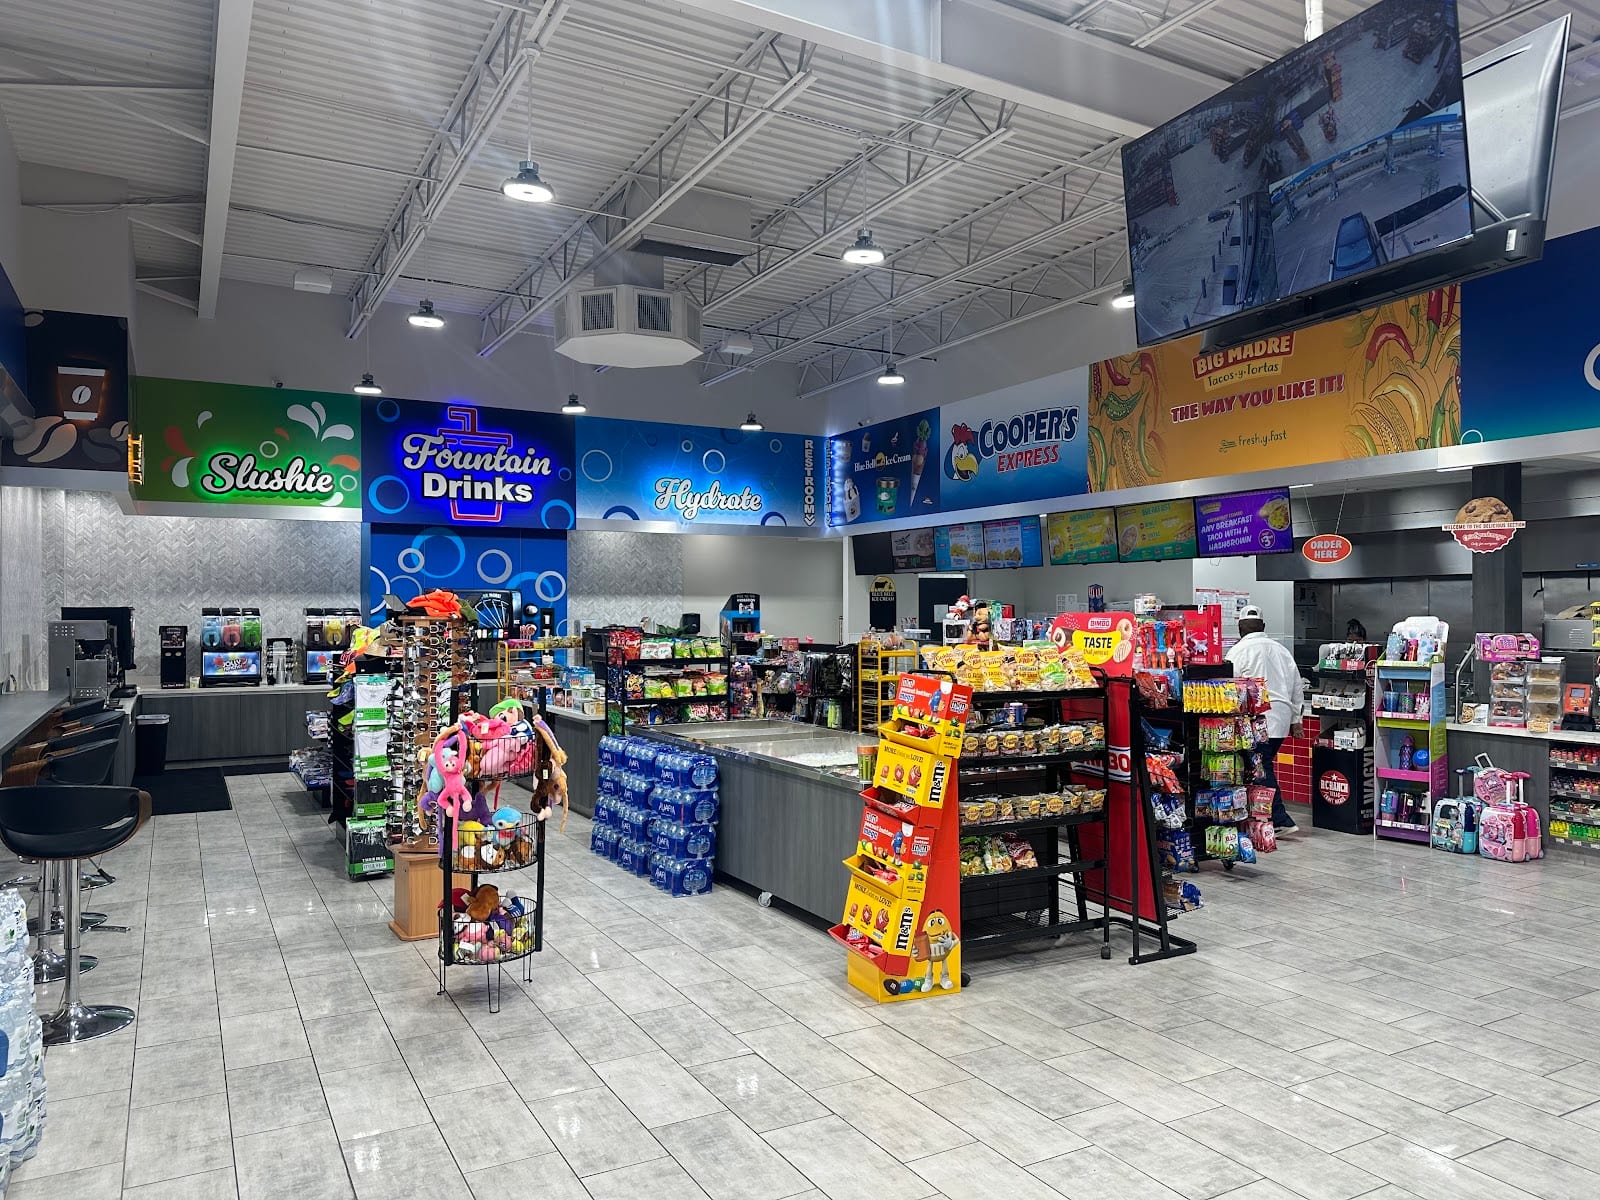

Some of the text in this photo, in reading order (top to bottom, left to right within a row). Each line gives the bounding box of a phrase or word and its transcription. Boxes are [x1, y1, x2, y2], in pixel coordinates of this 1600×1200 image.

[1196, 335, 1292, 375] BIG MADRE
[1170, 373, 1345, 424] THE WAY YOU LIKE IT!
[977, 405, 1080, 460] COOPER'S
[402, 431, 552, 476] Fountain
[997, 444, 1061, 473] EXPRESS
[202, 452, 336, 493] Slushie
[423, 472, 533, 503] Drinks
[804, 439, 815, 514] RESTROOM
[654, 476, 762, 520] Hydrate
[1201, 514, 1253, 535] ANY BREAKFAST
[1207, 526, 1249, 542] TACO WITH A
[1208, 535, 1252, 551] HASHBROWN
[1310, 540, 1342, 550] ORDER
[1314, 550, 1339, 559] HERE
[1083, 636, 1113, 649] TASTE
[223, 659, 241, 668] JOLLY
